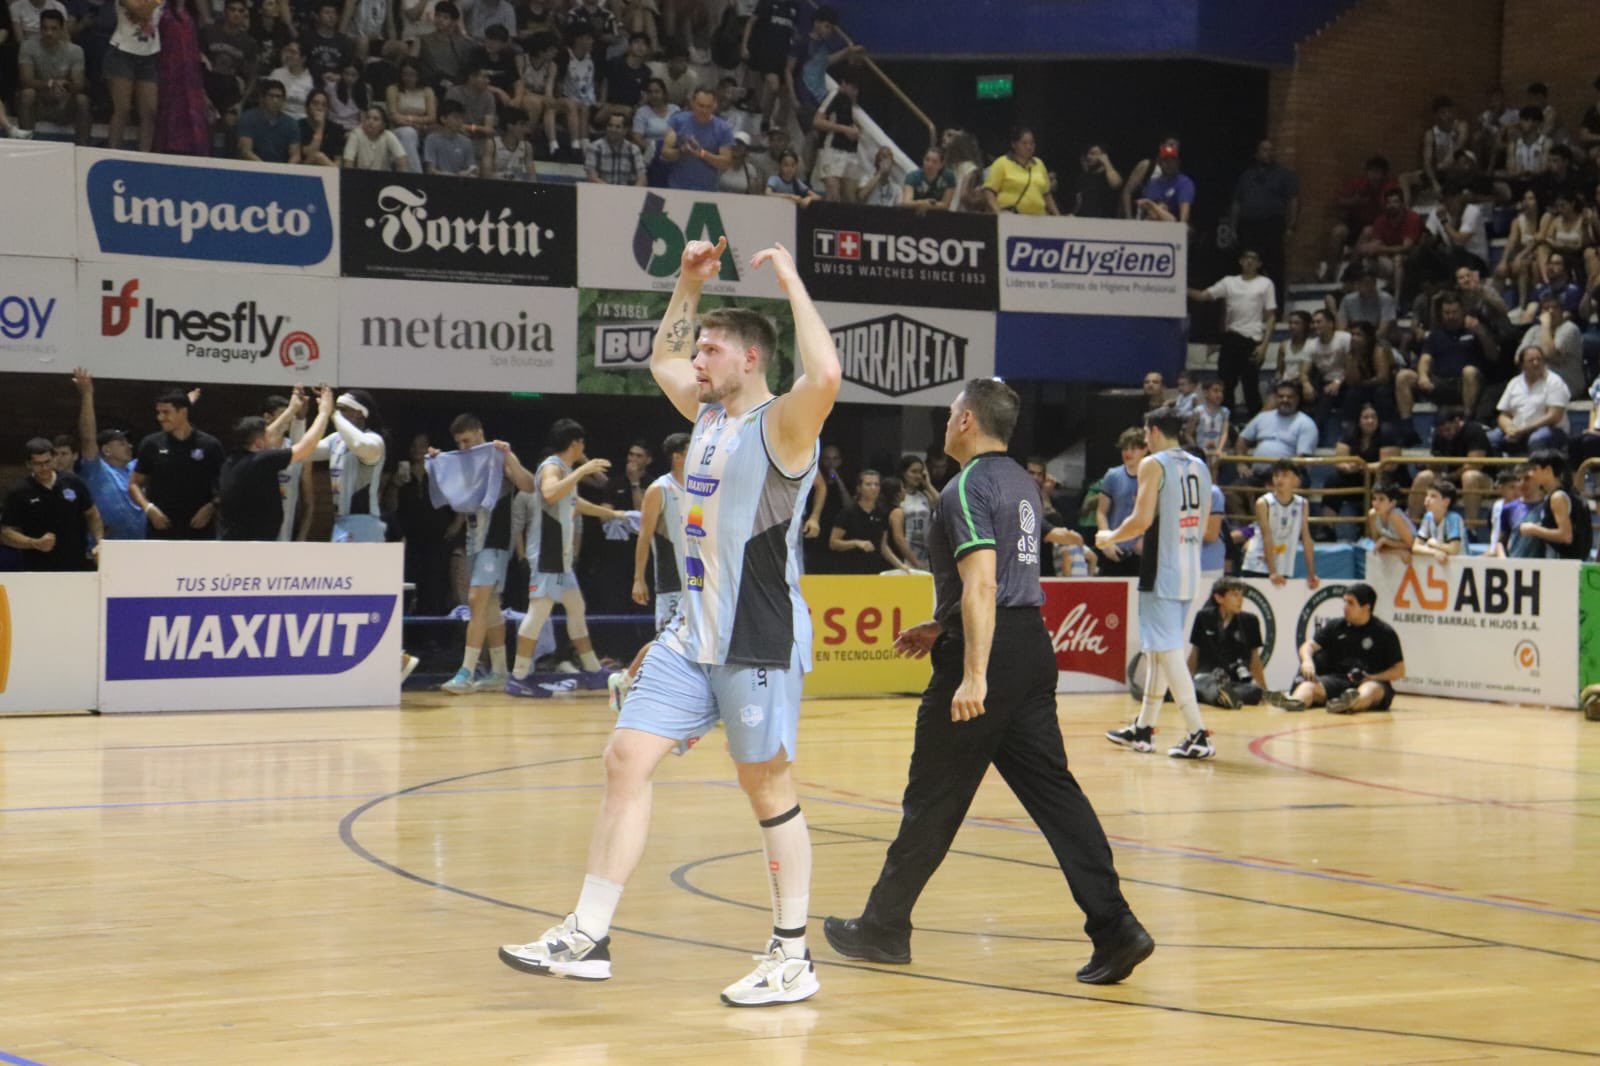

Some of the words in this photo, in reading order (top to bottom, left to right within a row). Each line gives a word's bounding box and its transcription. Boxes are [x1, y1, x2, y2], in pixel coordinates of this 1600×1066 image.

[112, 179, 311, 244] impacto
[378, 185, 542, 258] Fortín
[863, 232, 986, 268] TISSOT
[1010, 241, 1171, 274] ProHygiene
[814, 262, 853, 275] SWISS
[859, 266, 914, 280] WATCHES
[920, 270, 956, 283] SINCE
[961, 274, 987, 285] 1853
[145, 298, 285, 358] Inesfly
[597, 303, 610, 317] YA
[360, 311, 554, 352] metanoia
[601, 327, 659, 364] BU
[186, 343, 259, 363] Paraguay
[700, 445, 716, 466] 12
[1181, 474, 1200, 512] 10
[176, 577, 206, 592] TUS
[211, 573, 261, 591] SÚPER
[267, 576, 353, 591] VITAMINAS
[1454, 567, 1541, 617] ABH
[144, 612, 369, 661] MAXIVIT
[1051, 602, 1109, 655] litta
[1393, 612, 1434, 625] ALBERTO
[1437, 616, 1477, 628] BARRAIL
[1480, 619, 1487, 628] E
[1489, 619, 1518, 630] HIJOS
[1522, 621, 1541, 631] S.A.
[816, 651, 830, 661] EN
